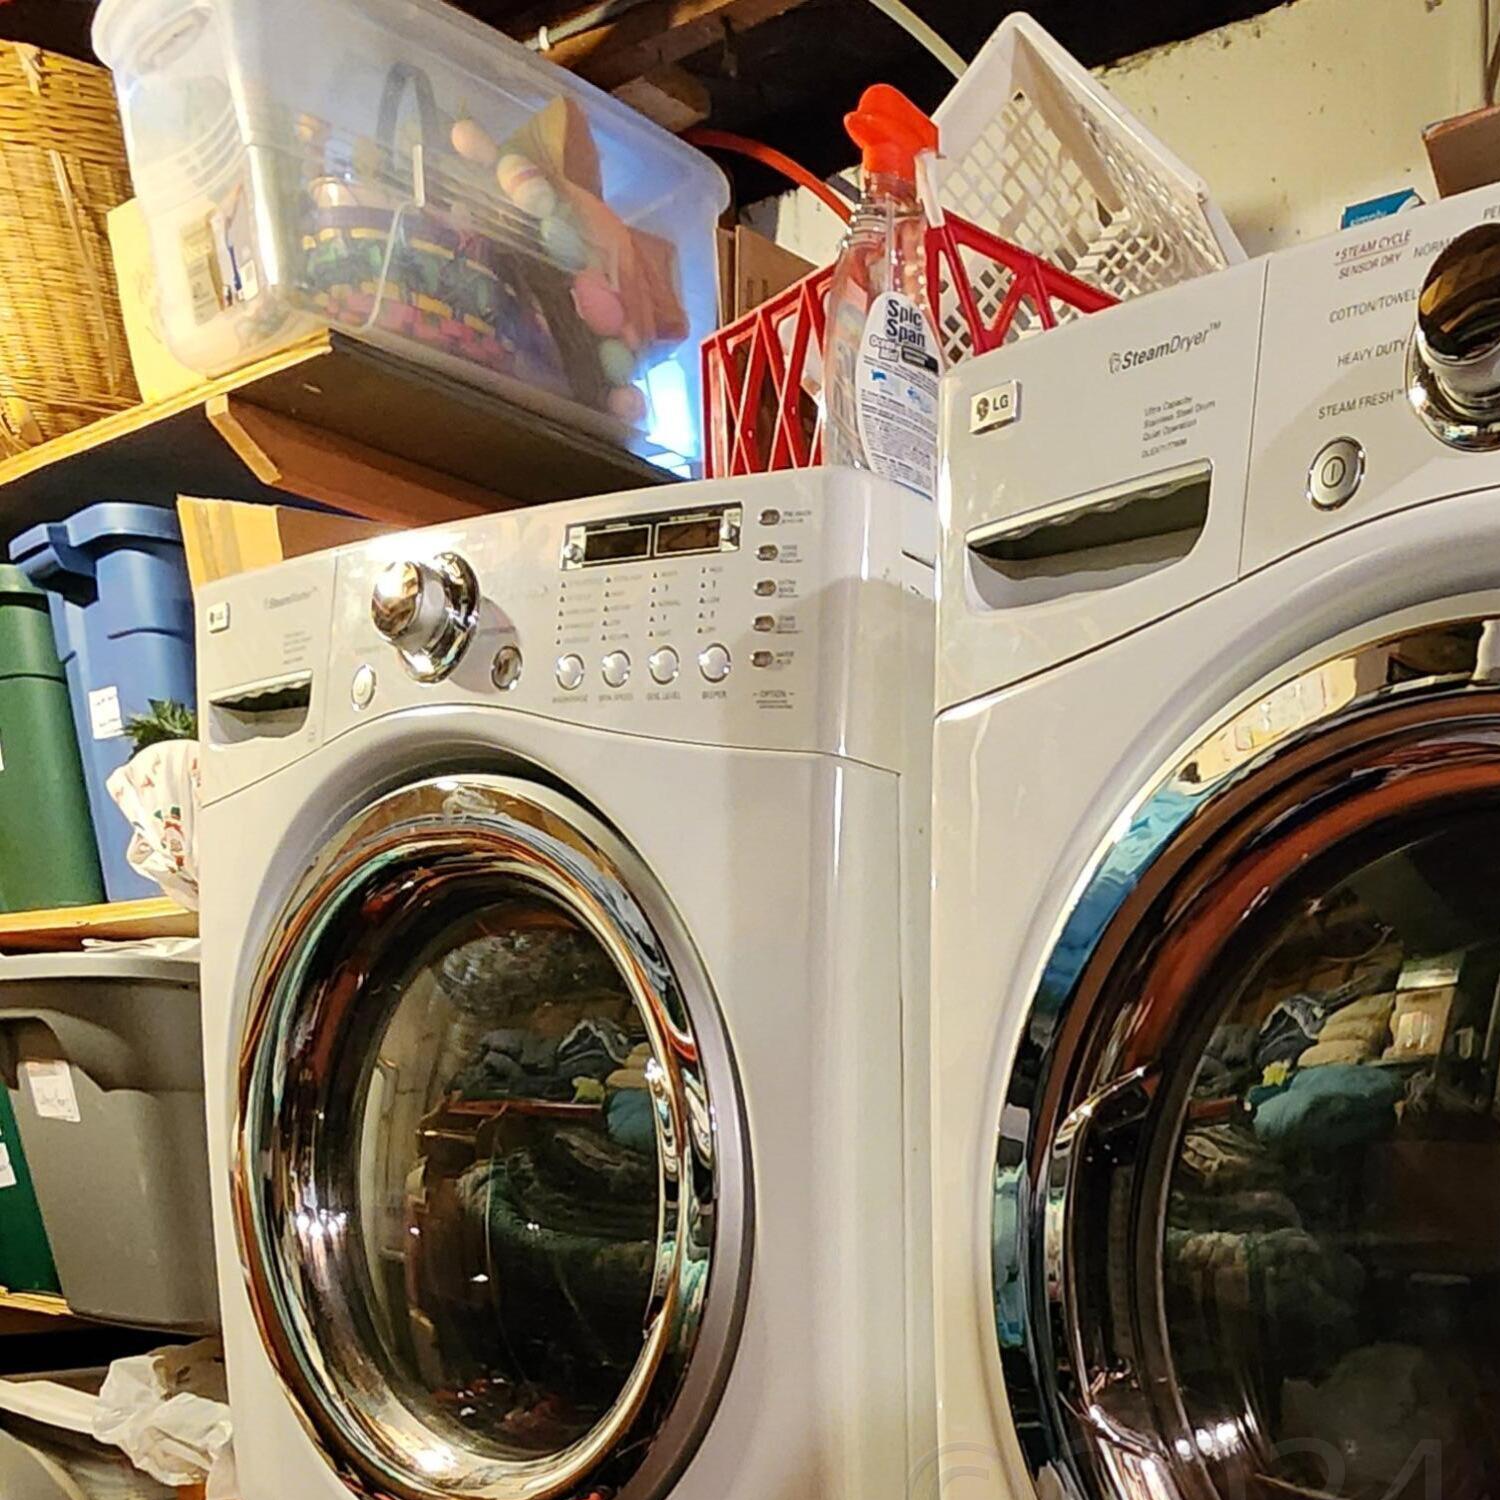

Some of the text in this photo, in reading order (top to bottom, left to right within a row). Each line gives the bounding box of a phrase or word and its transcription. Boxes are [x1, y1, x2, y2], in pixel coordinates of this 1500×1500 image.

[1379, 229, 1411, 249] CYCLE
[1339, 253, 1401, 279] SENSOR DRY
[887, 299, 922, 326] Spic
[886, 318, 925, 348] Span
[1337, 338, 1407, 368] HEAVY DUTY
[993, 394, 1009, 411] LG
[1318, 399, 1356, 420] STEAM
